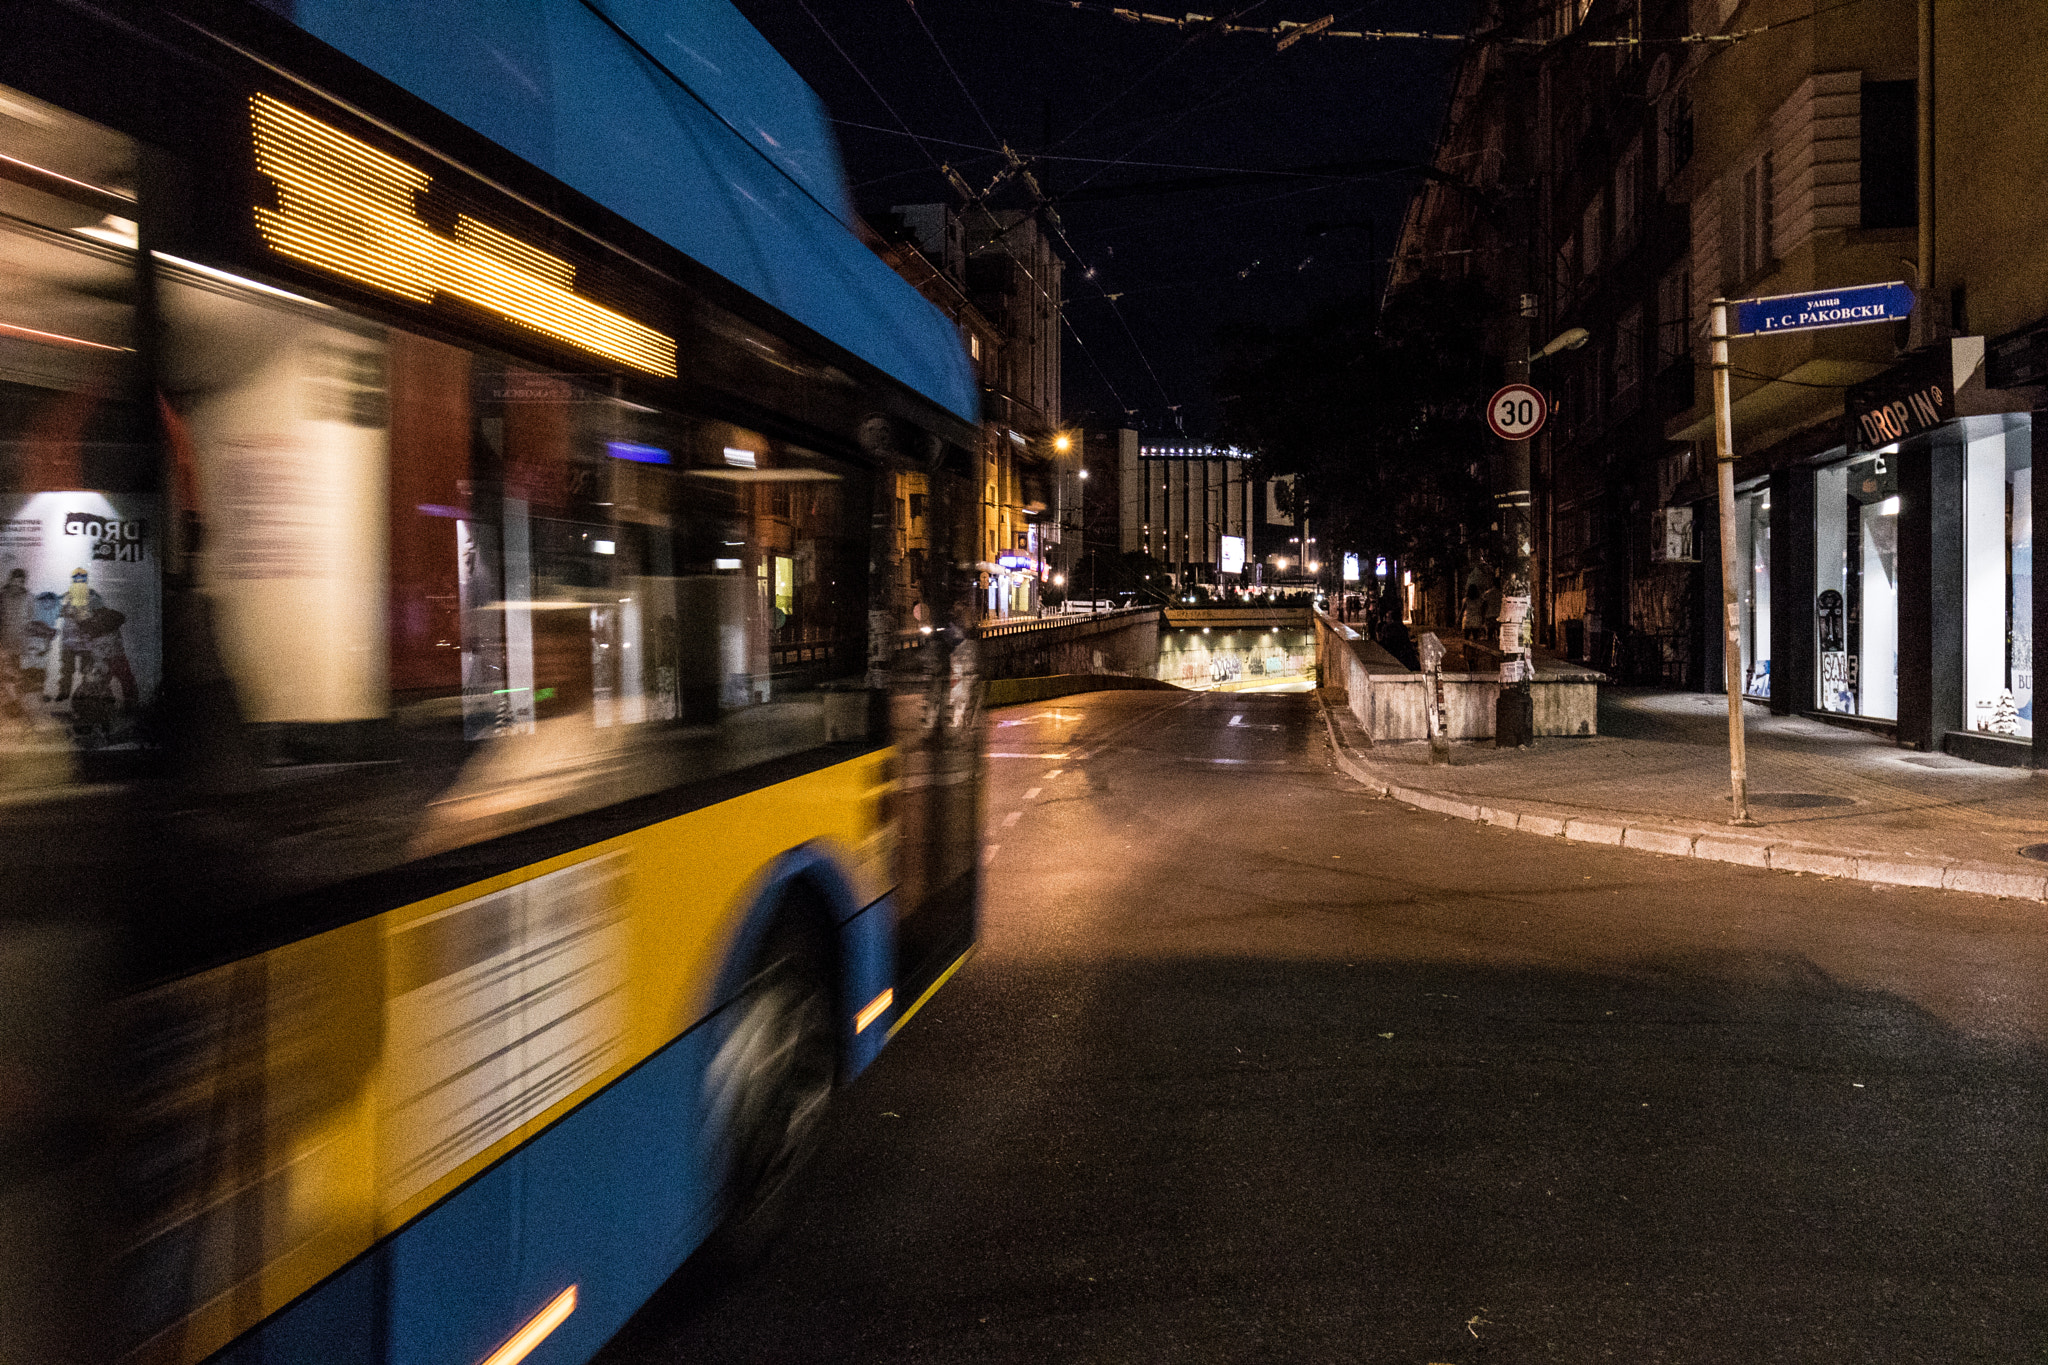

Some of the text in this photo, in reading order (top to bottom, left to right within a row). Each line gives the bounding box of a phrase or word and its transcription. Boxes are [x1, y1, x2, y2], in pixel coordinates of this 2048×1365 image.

[1766, 303, 1885, 328] Г. С. РАКОВСКИ
[1807, 297, 1840, 311] улица
[1501, 399, 1533, 426] 30
[1860, 400, 1910, 446] DROP
